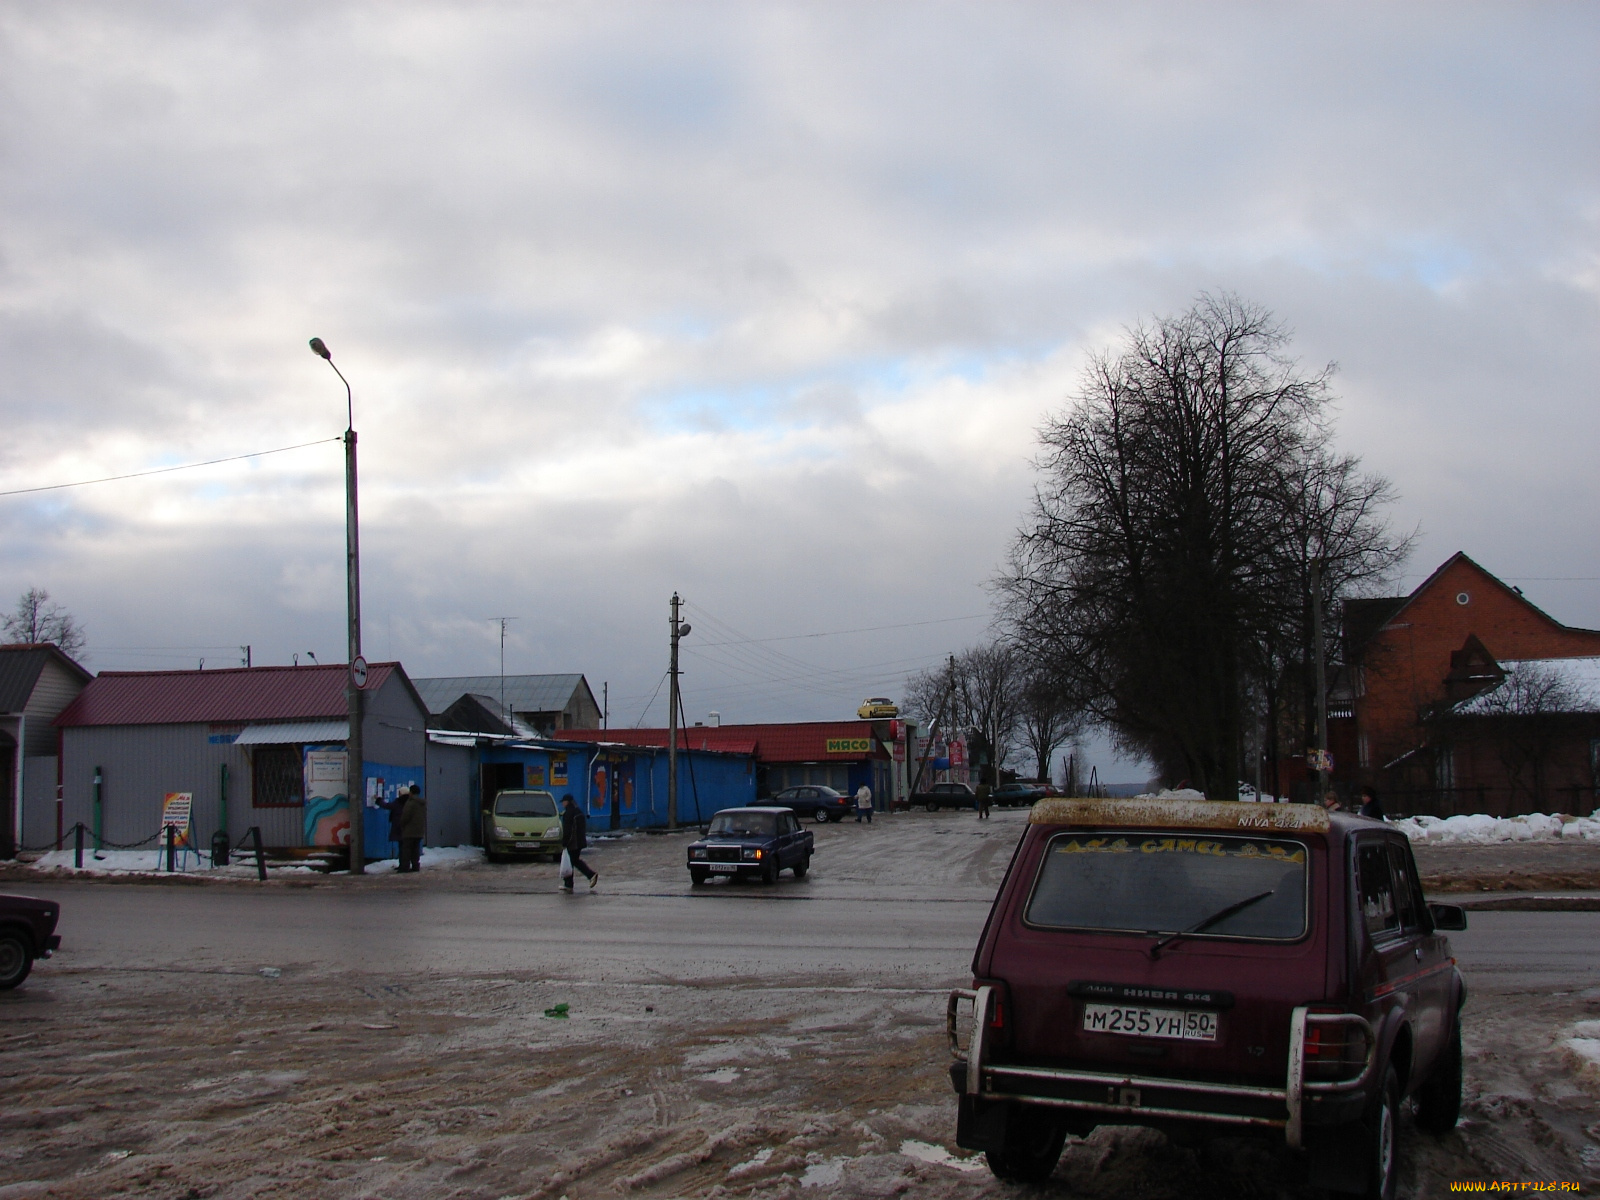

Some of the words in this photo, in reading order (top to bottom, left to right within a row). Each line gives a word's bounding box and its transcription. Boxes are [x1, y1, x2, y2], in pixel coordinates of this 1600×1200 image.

[828, 740, 868, 750] МЯСО
[1238, 818, 1269, 827] NIVA
[1140, 839, 1227, 856] CAMEL
[1187, 1014, 1209, 1031] 50
[1185, 1030, 1202, 1038] RUS
